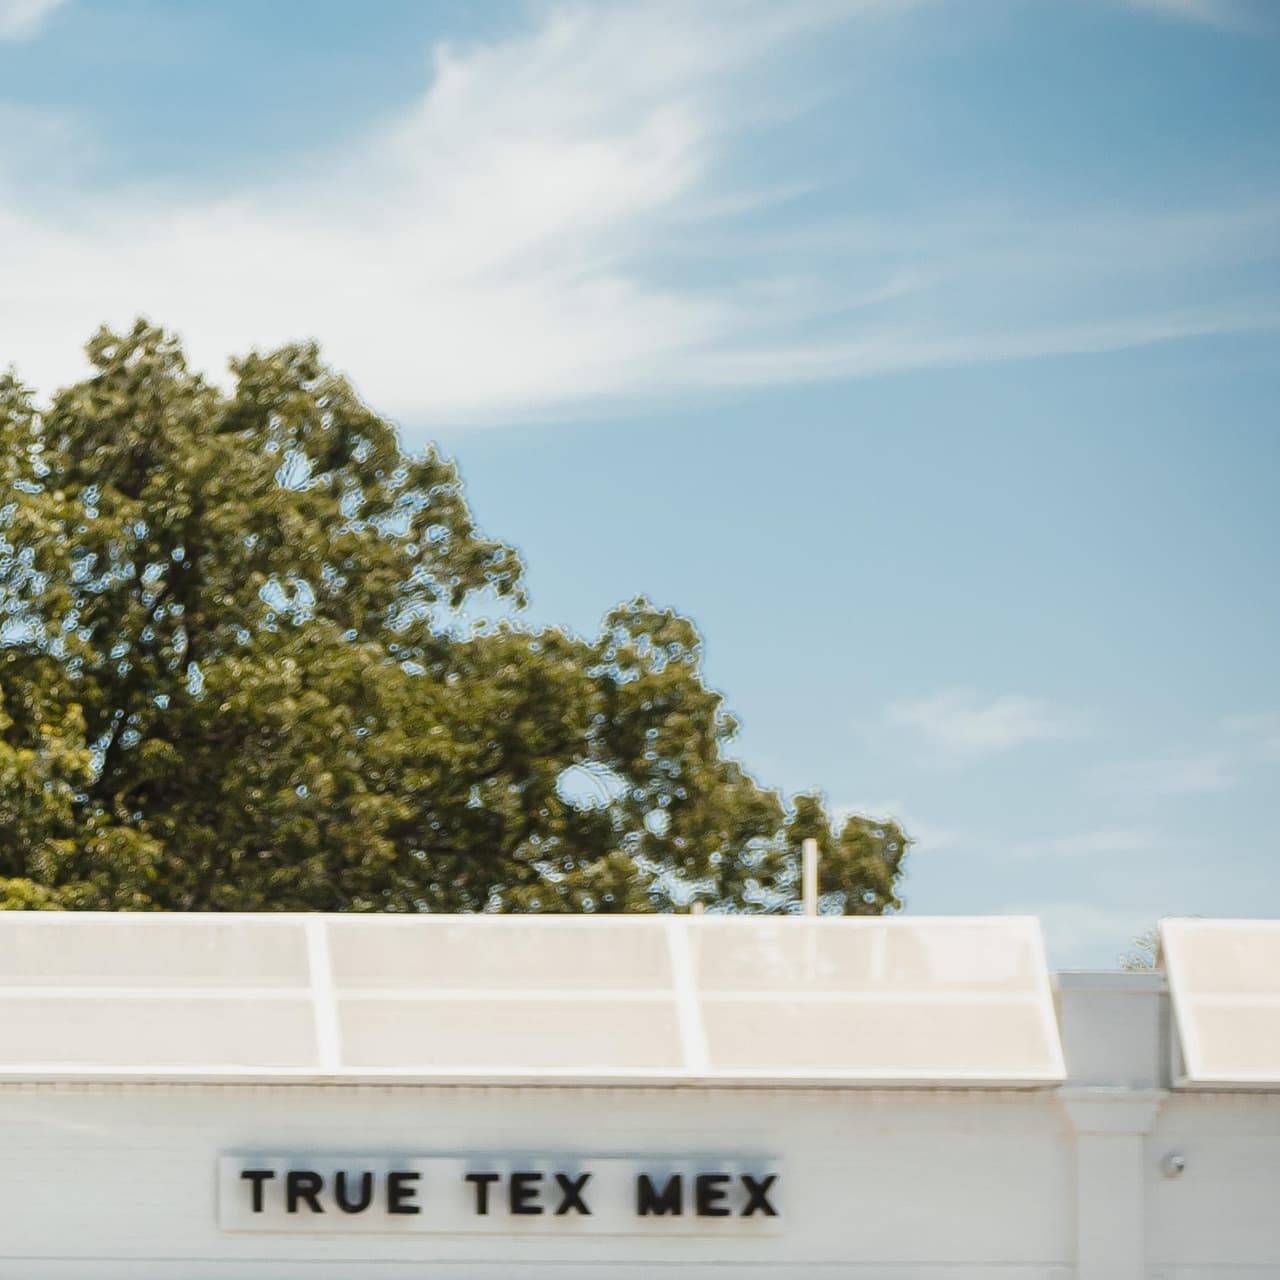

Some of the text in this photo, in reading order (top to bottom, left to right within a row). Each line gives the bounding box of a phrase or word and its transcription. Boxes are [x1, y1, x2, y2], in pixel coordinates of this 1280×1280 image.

[241, 1170, 779, 1217] TRUE TEX MEX
